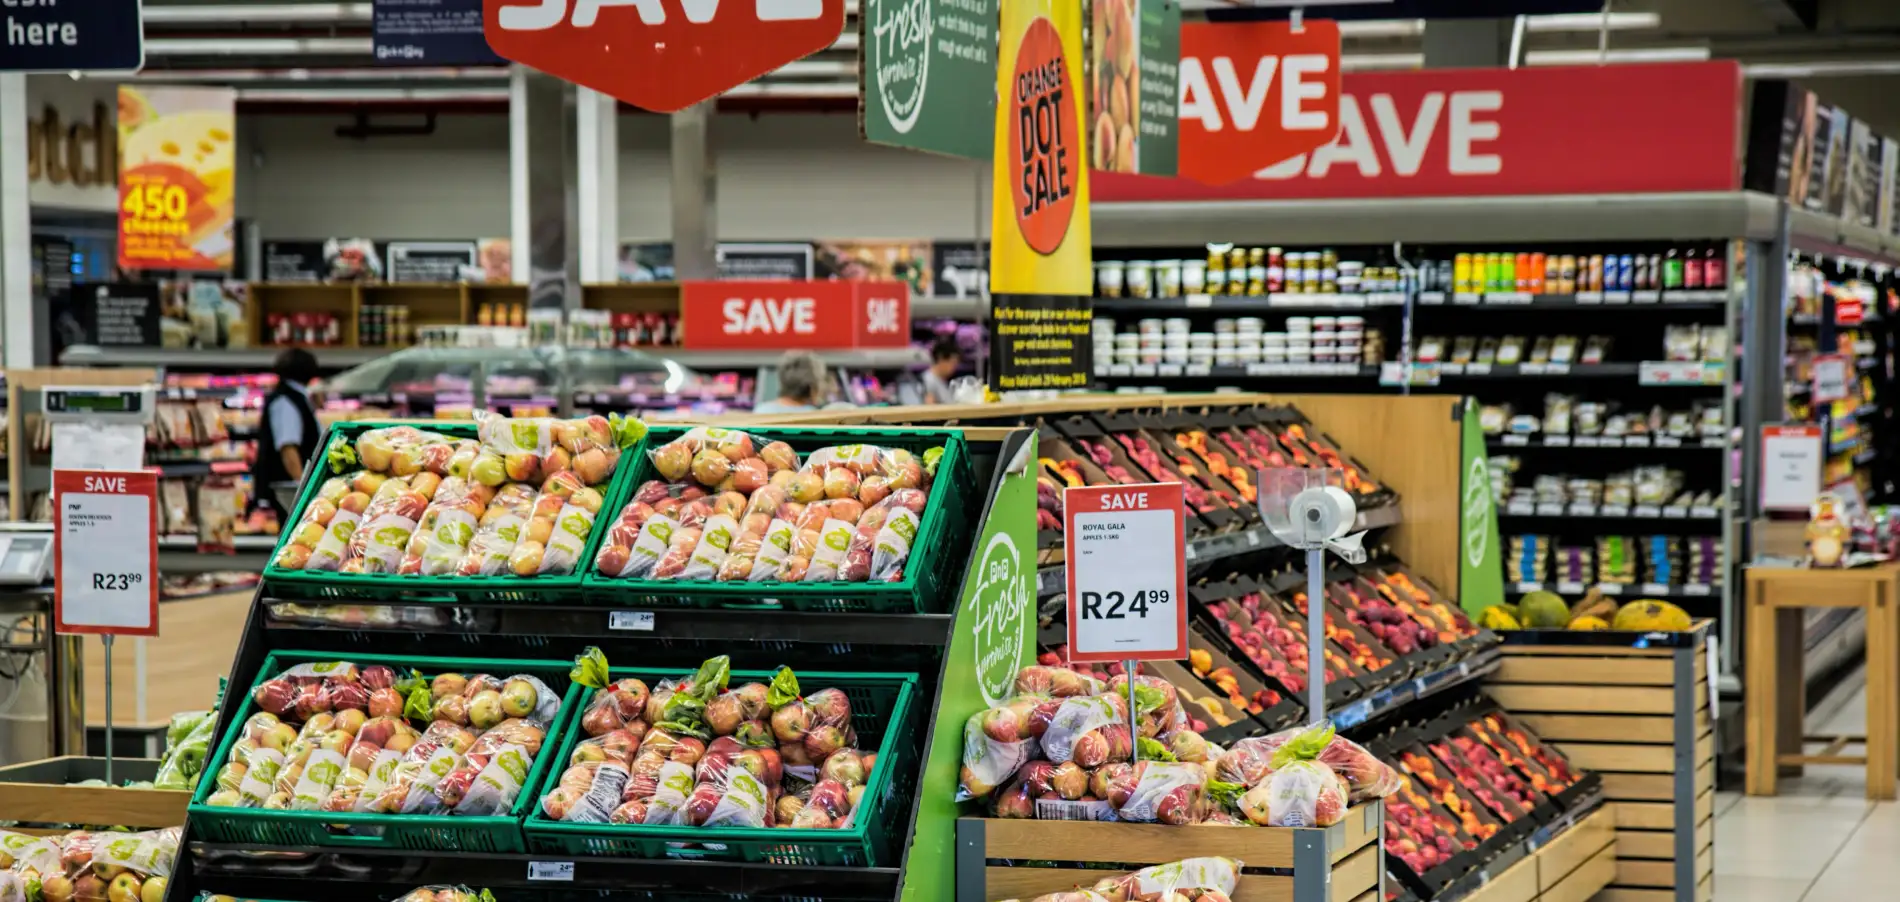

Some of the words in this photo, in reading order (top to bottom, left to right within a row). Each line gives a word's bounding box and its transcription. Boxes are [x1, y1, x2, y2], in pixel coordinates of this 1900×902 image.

[7, 15, 78, 46] here
[1018, 57, 1062, 104] ORANGE
[1179, 55, 1329, 131] AVE
[1019, 90, 1062, 165] DOT
[1254, 91, 1503, 179] AVE
[123, 184, 188, 219] 450
[1022, 148, 1070, 218] SALE
[722, 298, 816, 334] SAVE
[867, 297, 899, 334] SAVE
[84, 476, 126, 492] SAVE
[1101, 492, 1148, 509] SAVE
[969, 550, 1030, 646] Fresh
